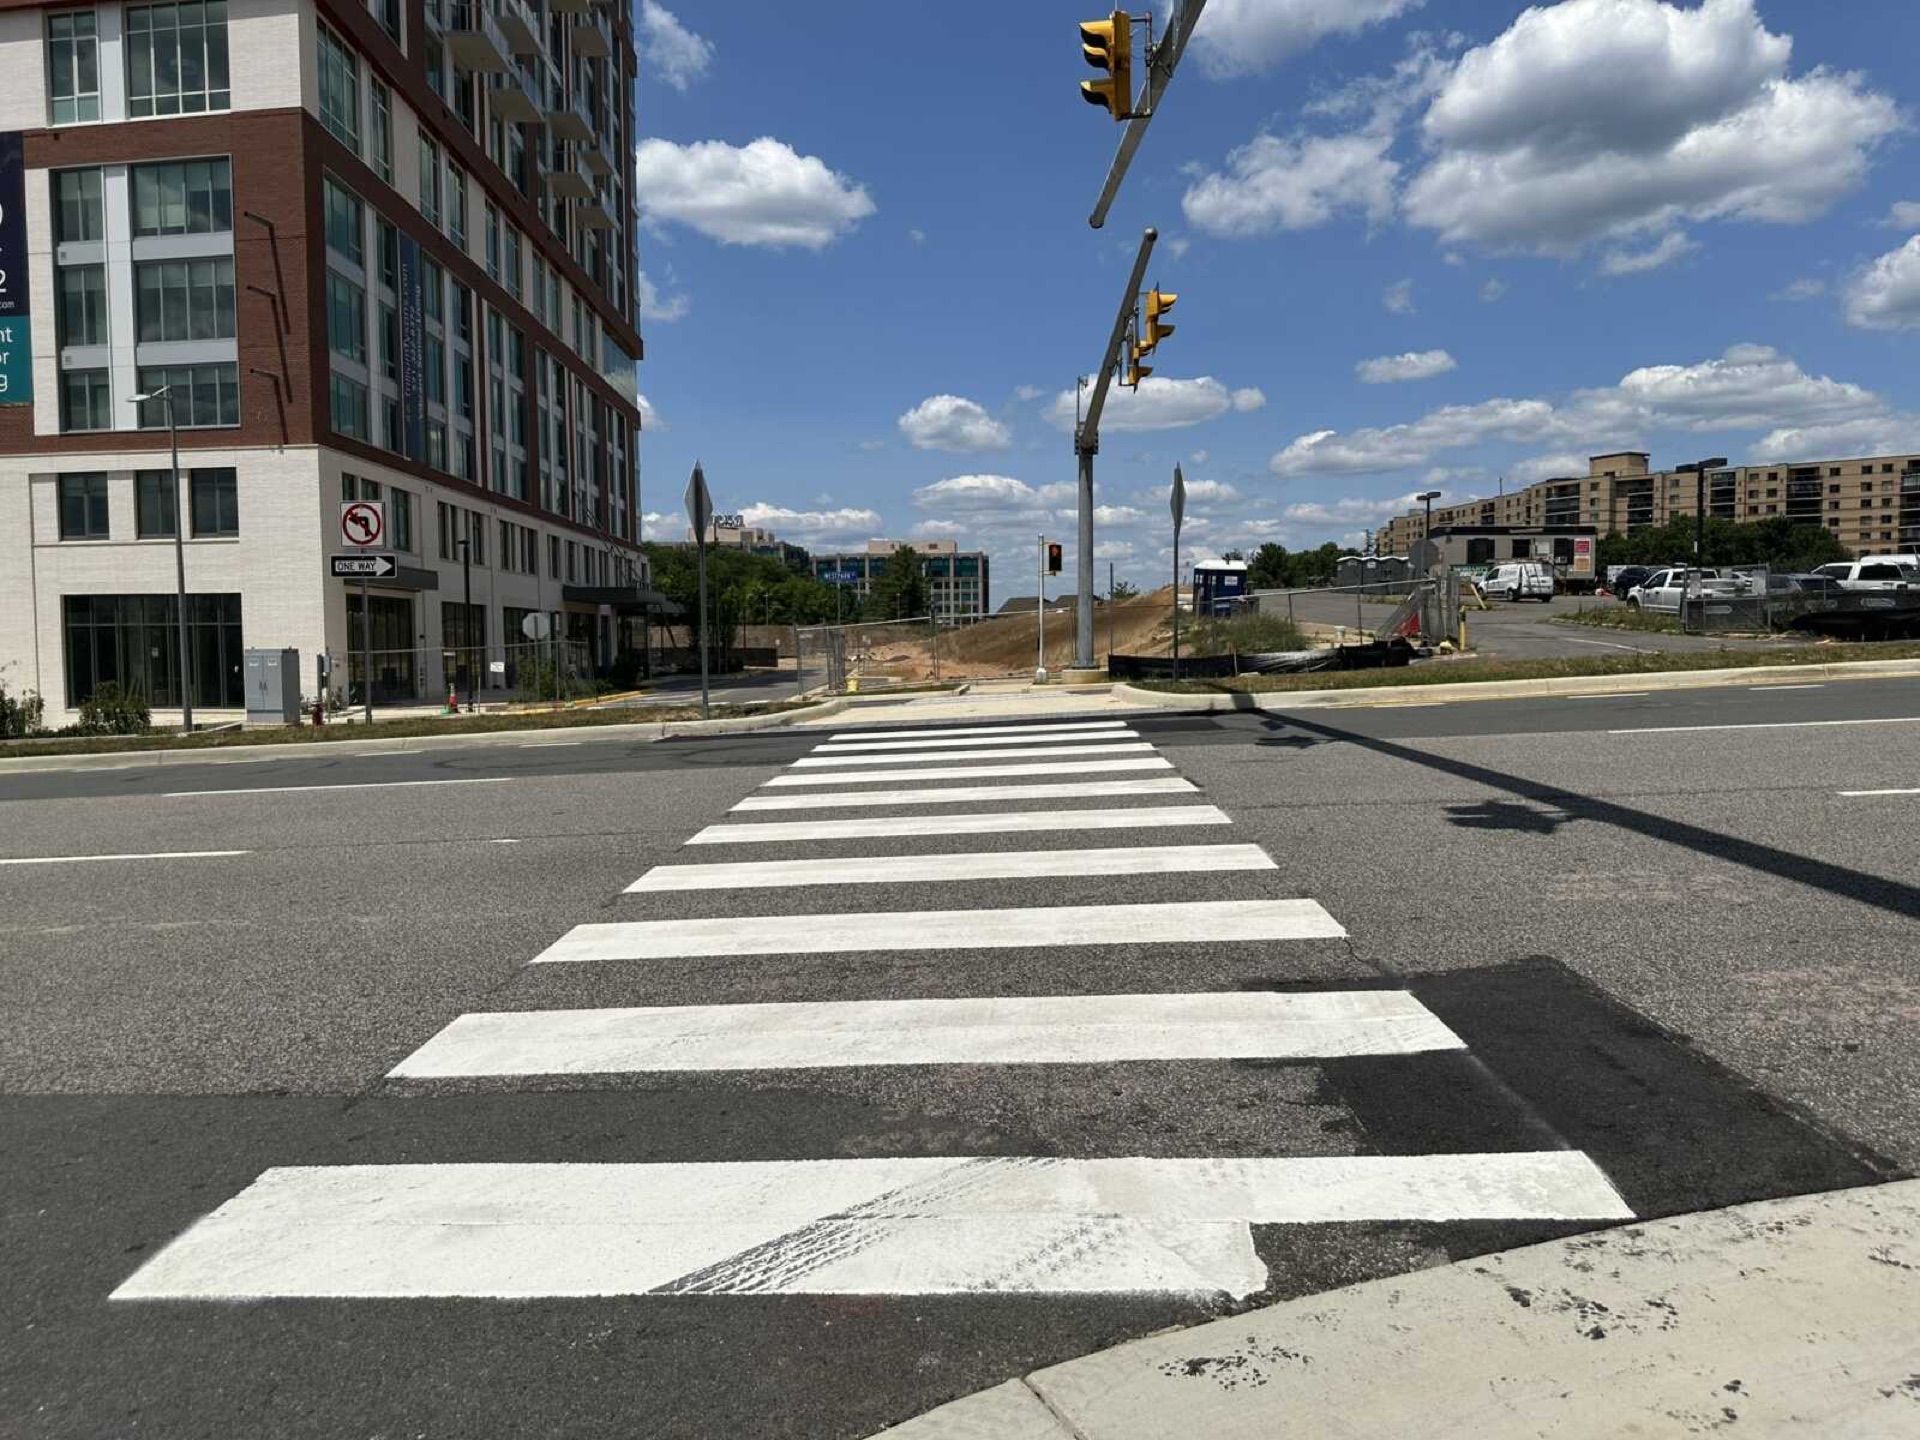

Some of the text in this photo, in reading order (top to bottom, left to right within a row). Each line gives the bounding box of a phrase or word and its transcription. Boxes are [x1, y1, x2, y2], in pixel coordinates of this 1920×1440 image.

[0, 351, 10, 365] r
[337, 561, 375, 571] ONE WAY
